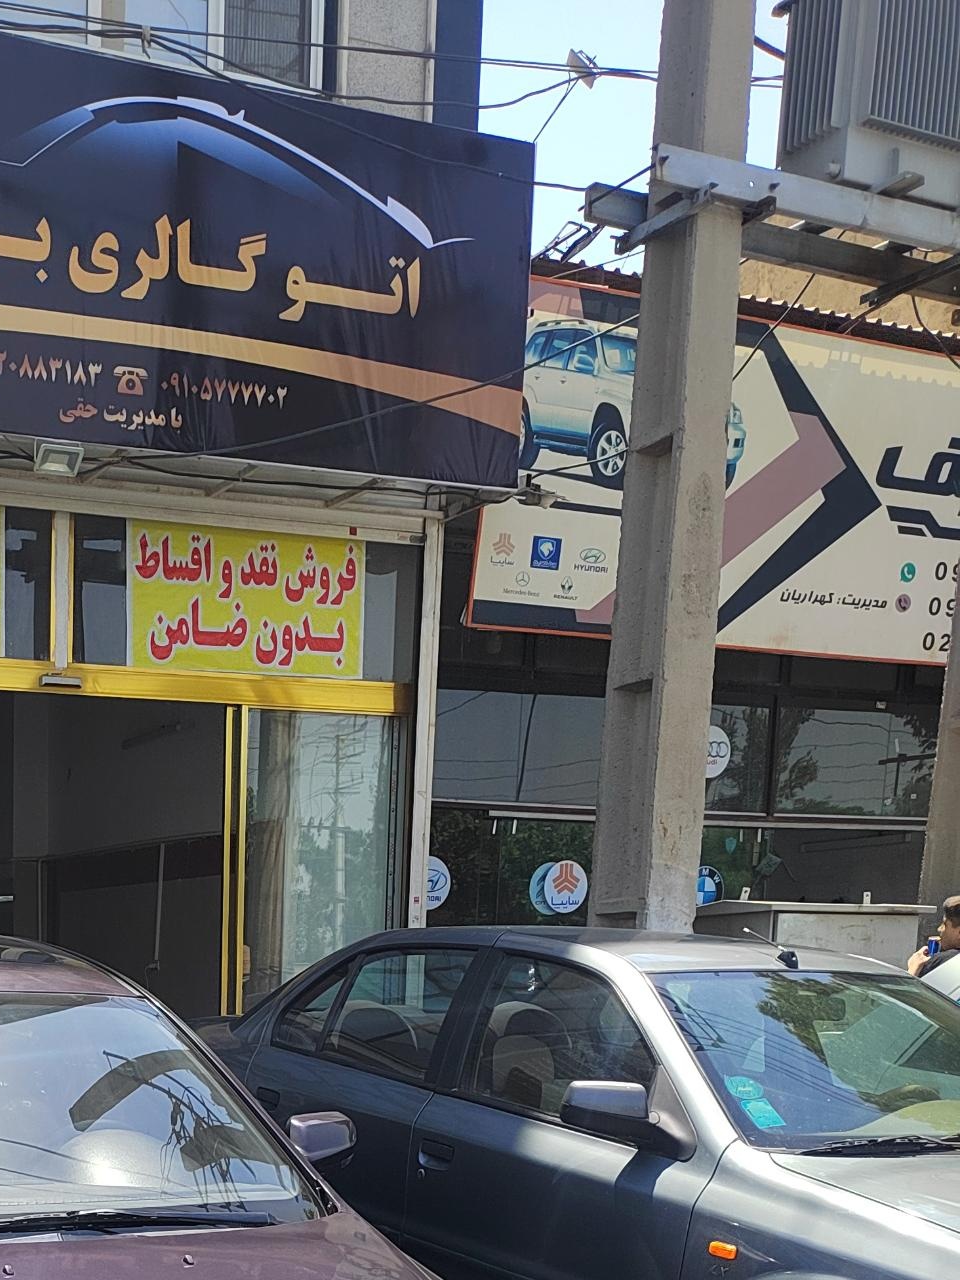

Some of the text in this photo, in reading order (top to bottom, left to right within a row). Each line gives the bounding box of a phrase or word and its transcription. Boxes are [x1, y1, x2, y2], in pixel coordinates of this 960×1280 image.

[68, 213, 268, 300] گالری
[278, 255, 421, 322] اتو
[59, 397, 183, 434] با مدیریت حقی
[135, 532, 357, 605] فروش نقد و اقساط
[553, 593, 579, 601] RENAULT
[573, 563, 609, 574] HYUNDAI
[149, 596, 345, 667] بدون ضامن
